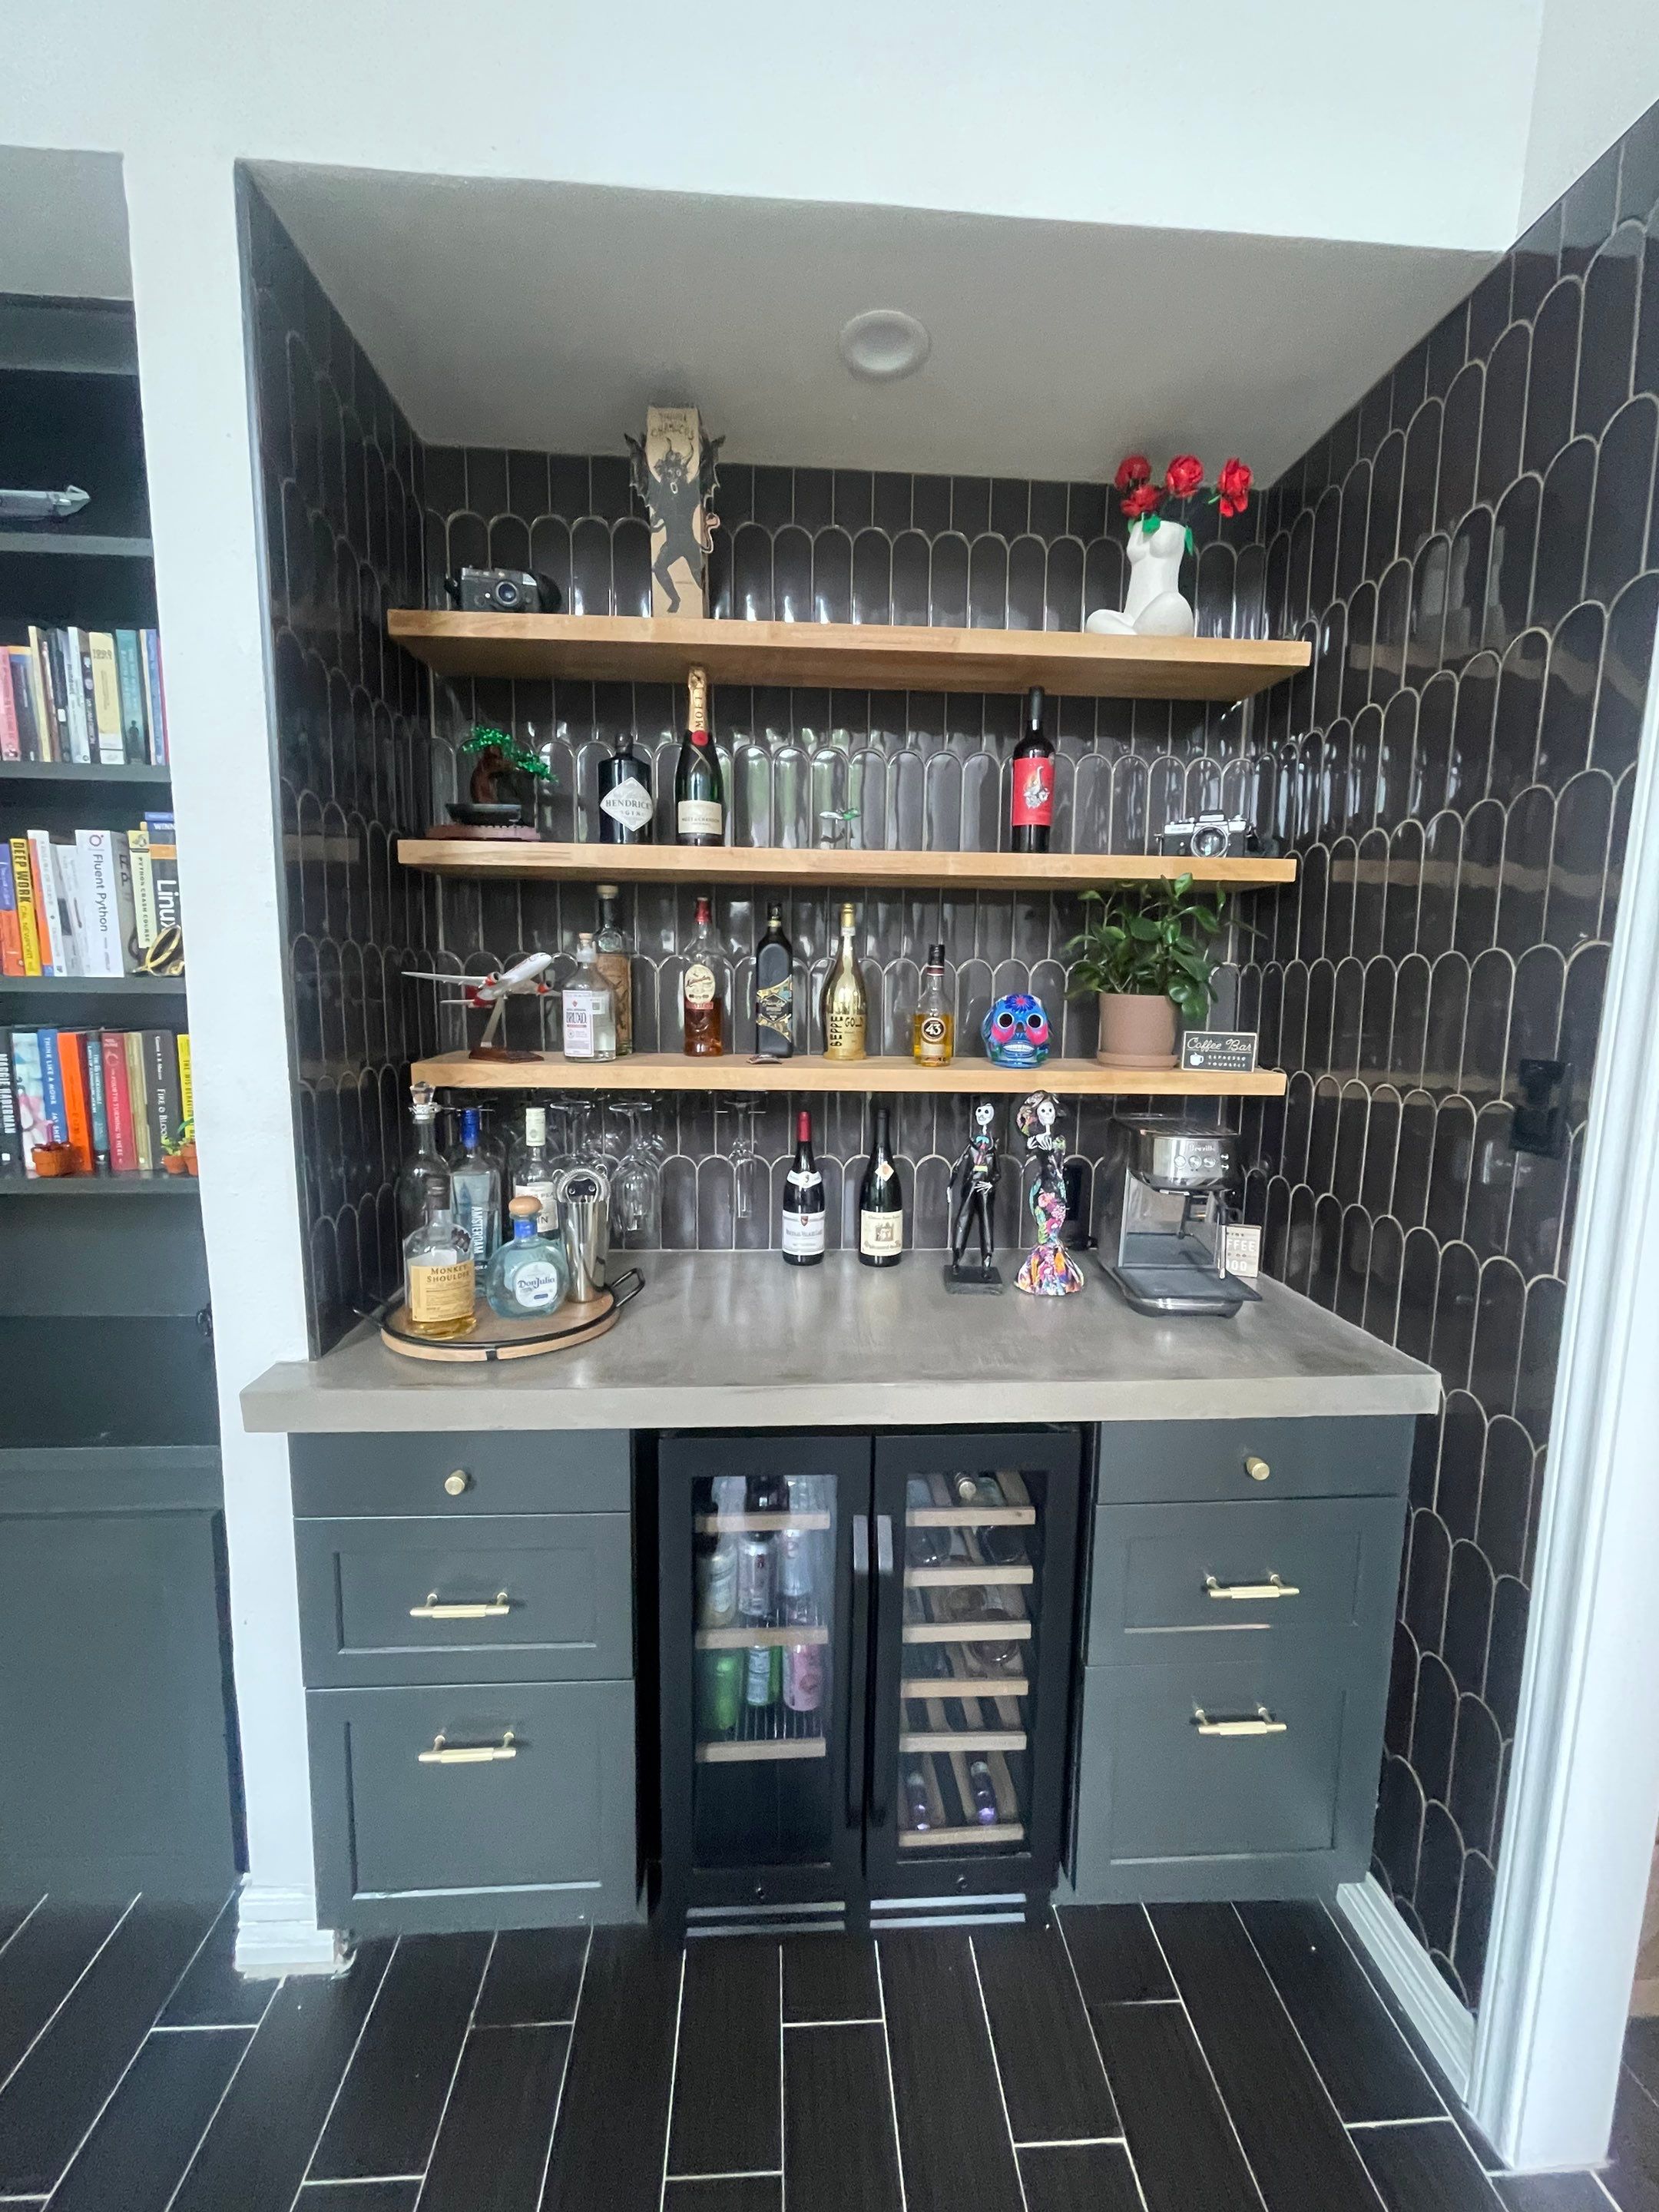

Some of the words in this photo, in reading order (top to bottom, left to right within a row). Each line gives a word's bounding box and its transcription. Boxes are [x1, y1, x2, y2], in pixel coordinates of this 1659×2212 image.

[13, 842, 28, 868] DEEP
[92, 853, 105, 889] Fluent
[17, 871, 31, 903] WORK
[95, 892, 109, 932] Python
[157, 879, 179, 929] Linux
[830, 1015, 843, 1047] BEPPE
[925, 1022, 942, 1035] 43
[44, 1037, 52, 1058] THINK
[1187, 1037, 1222, 1052] Coffee
[1225, 1038, 1252, 1052] Bar
[46, 1059, 55, 1076] LIKE
[0, 1088, 16, 1134] HABERMAN
[159, 1114, 167, 1137] BLOO
[472, 1206, 485, 1254] AMSTERDAM
[1227, 1238, 1257, 1253] FFEE
[431, 1263, 468, 1276] MONKEY
